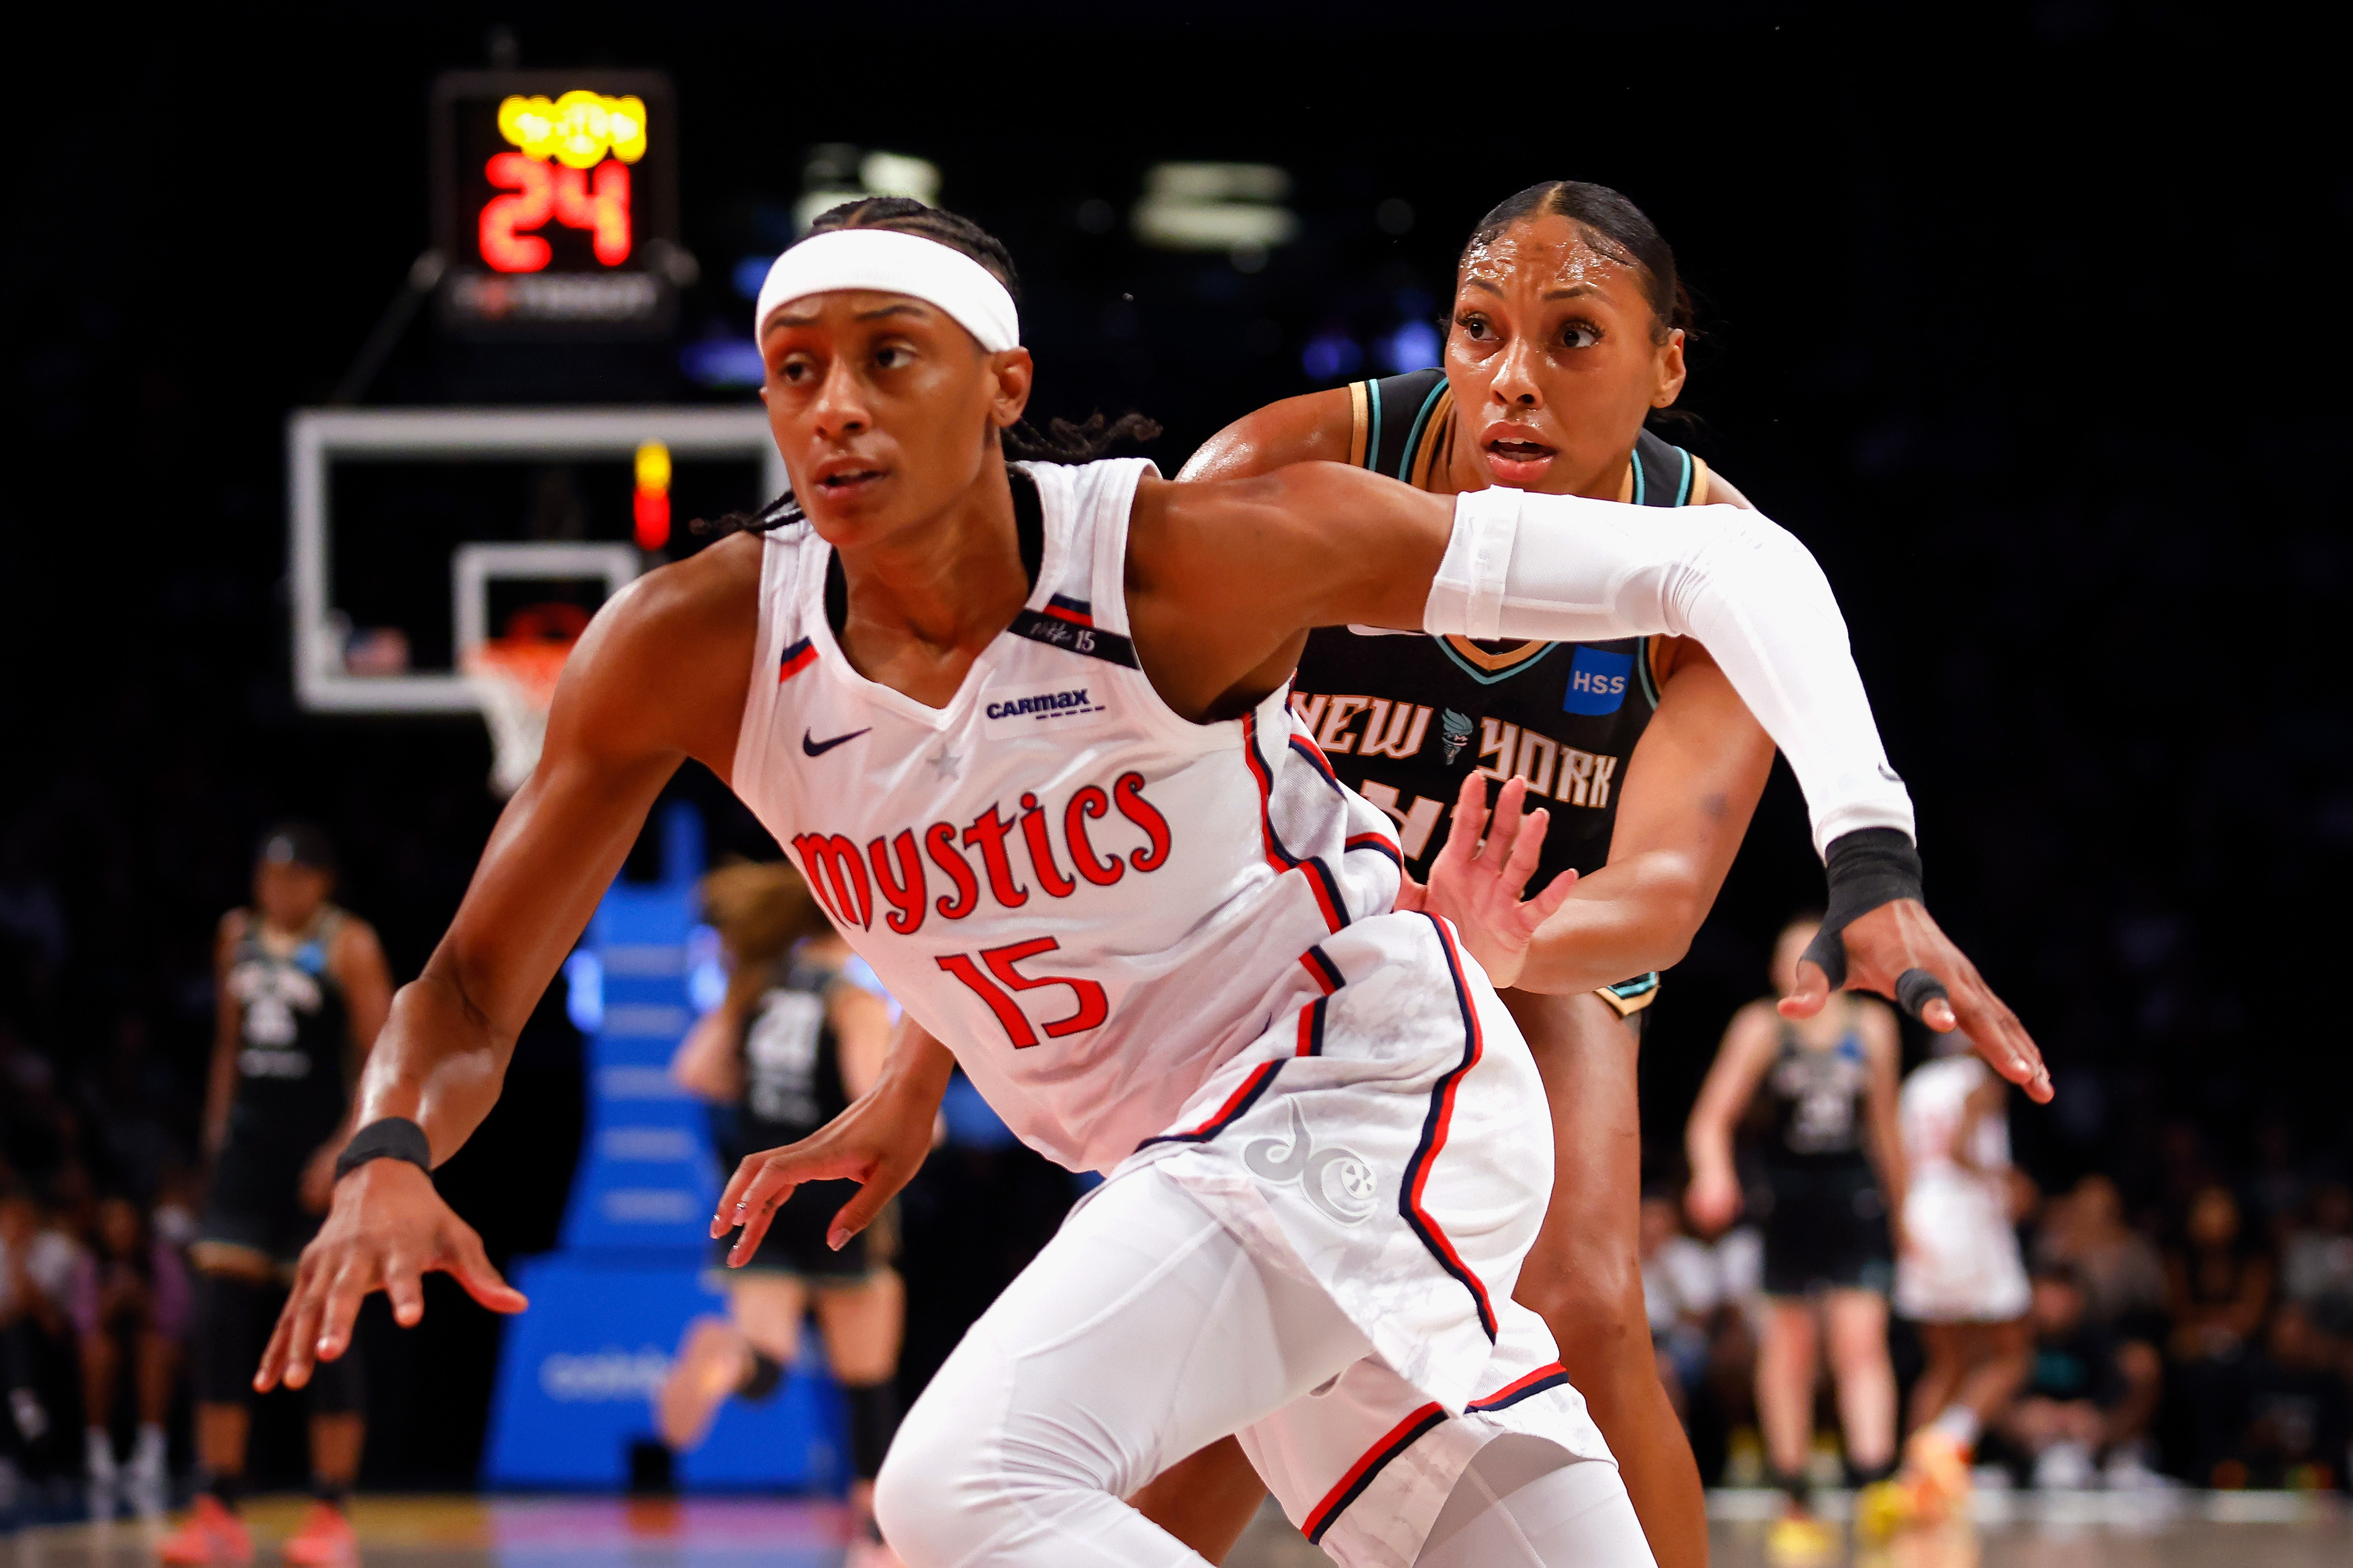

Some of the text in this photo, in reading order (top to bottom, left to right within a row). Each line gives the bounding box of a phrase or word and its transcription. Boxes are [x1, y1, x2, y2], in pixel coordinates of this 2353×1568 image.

[479, 152, 631, 273] 24
[1074, 629, 1096, 652] 15
[1573, 670, 1625, 695] HSS
[1290, 691, 1617, 809] NEW YORK
[935, 936, 1109, 1049] 15
